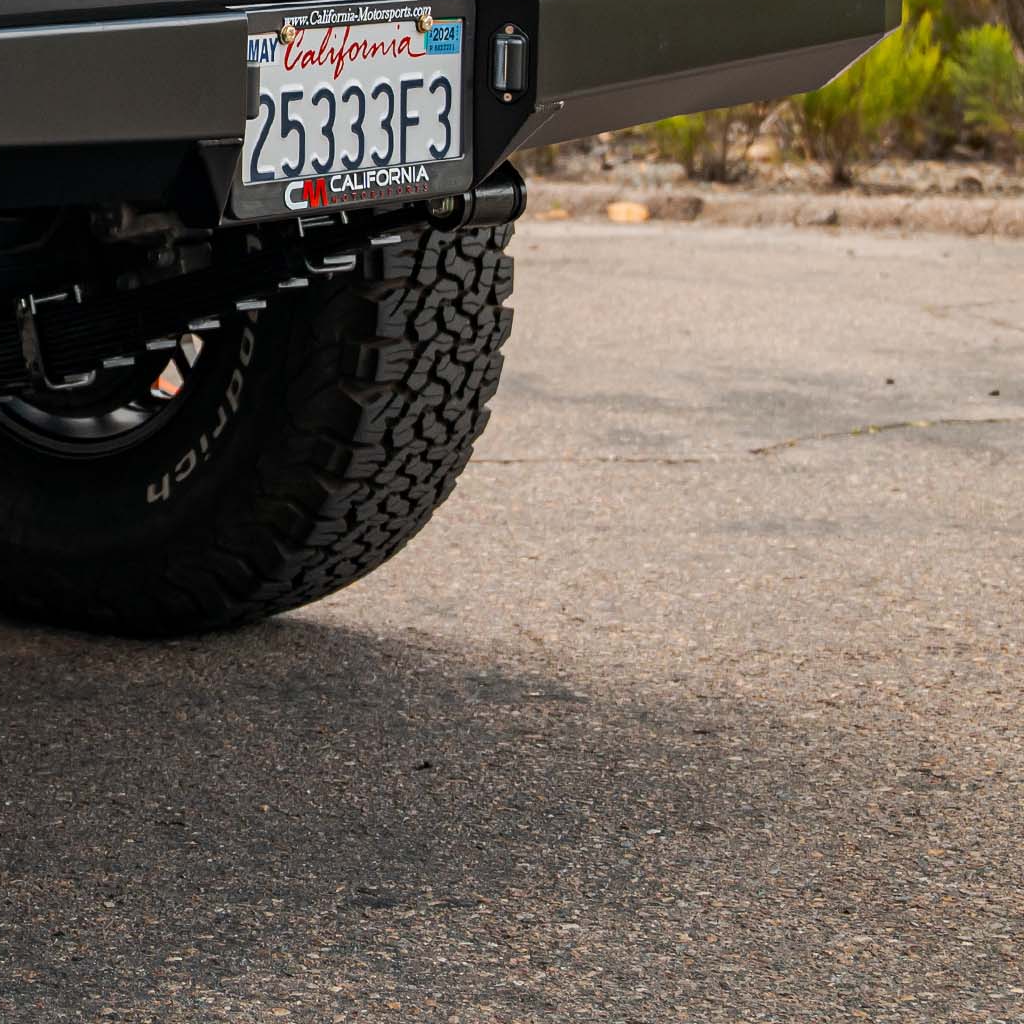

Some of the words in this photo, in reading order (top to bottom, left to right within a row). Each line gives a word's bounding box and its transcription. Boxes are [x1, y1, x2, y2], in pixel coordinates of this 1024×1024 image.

[248, 37, 277, 63] MAY
[284, 25, 426, 80] California
[433, 27, 455, 41] 2024
[250, 76, 452, 183] 25333F3
[284, 177, 328, 210] CM
[330, 164, 430, 192] CALIFORNIA
